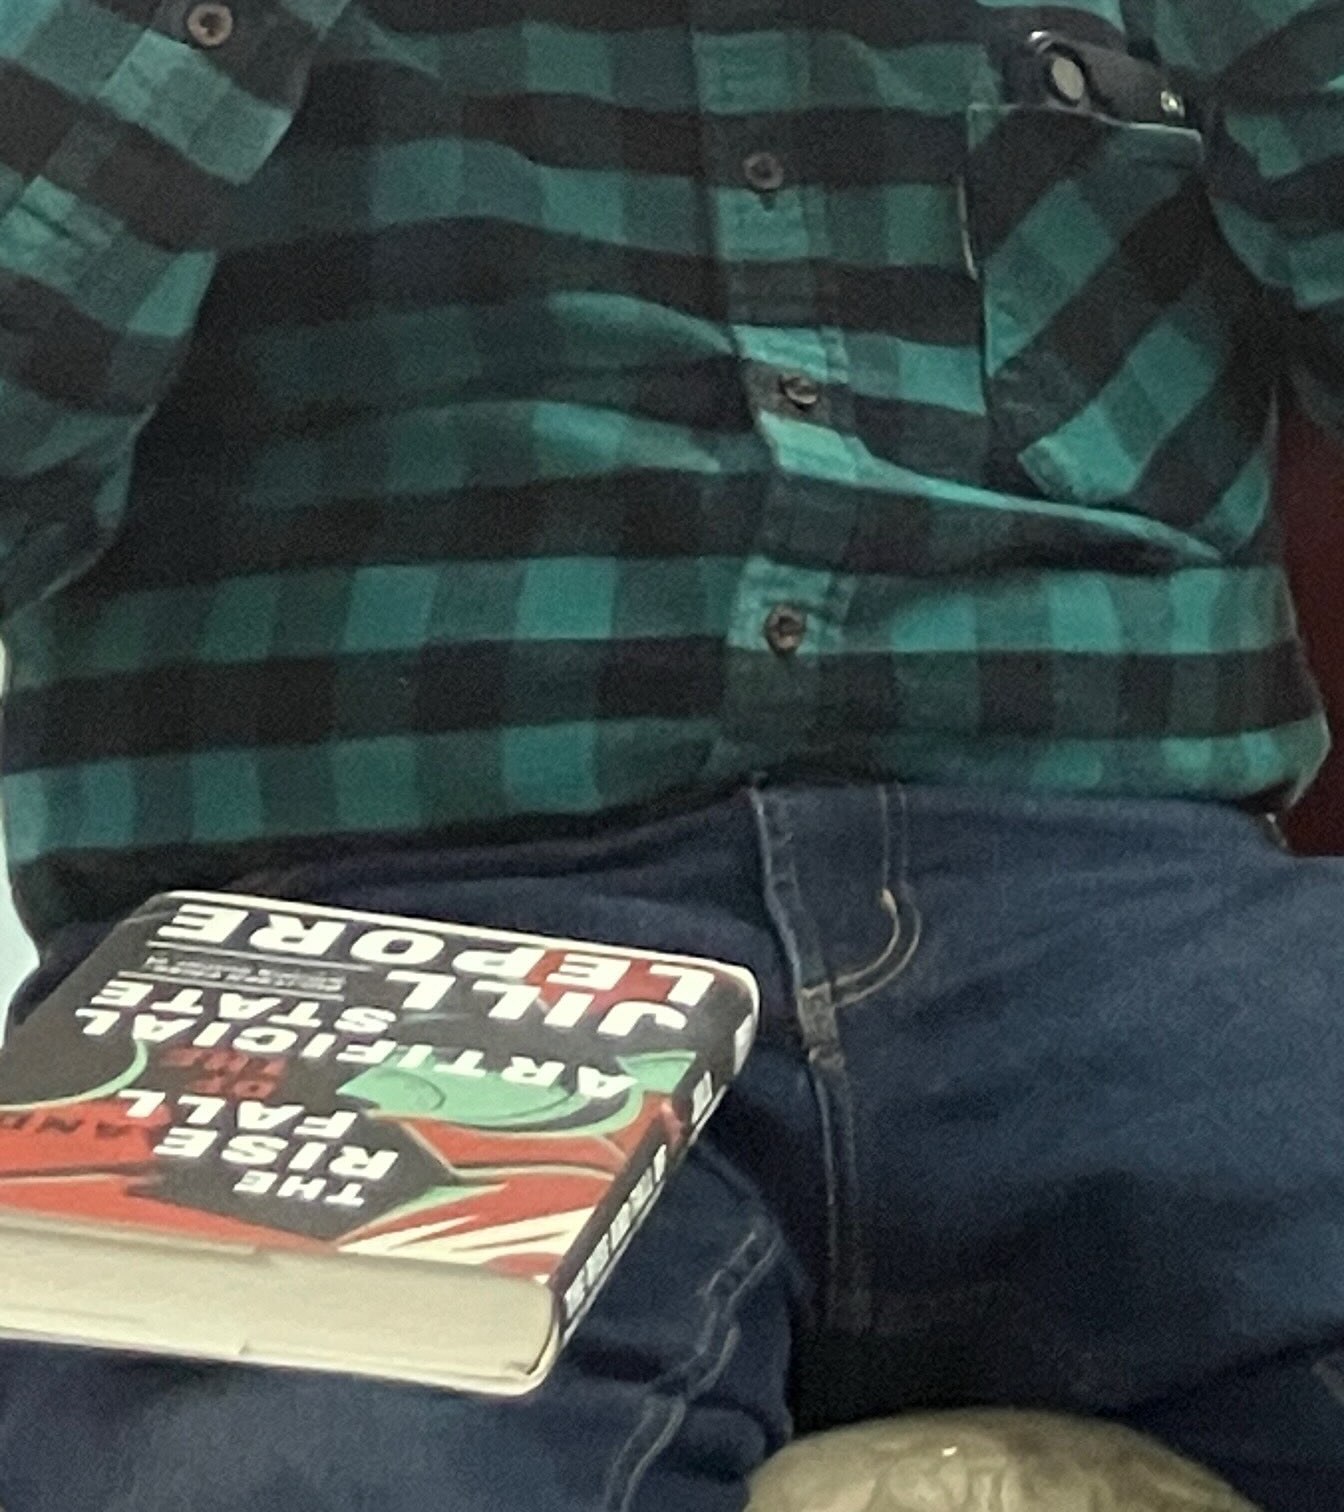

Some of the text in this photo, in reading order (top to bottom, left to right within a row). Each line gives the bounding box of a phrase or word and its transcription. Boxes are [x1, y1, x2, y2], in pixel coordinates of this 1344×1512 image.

[158, 902, 716, 1005] LEPORE
[99, 979, 397, 1035] STATE
[386, 970, 690, 1036] JILL
[75, 1007, 638, 1097] ARTIFICIAL
[119, 1089, 358, 1142] FALL
[154, 1127, 400, 1182] RISE
[231, 1171, 366, 1208] THE
